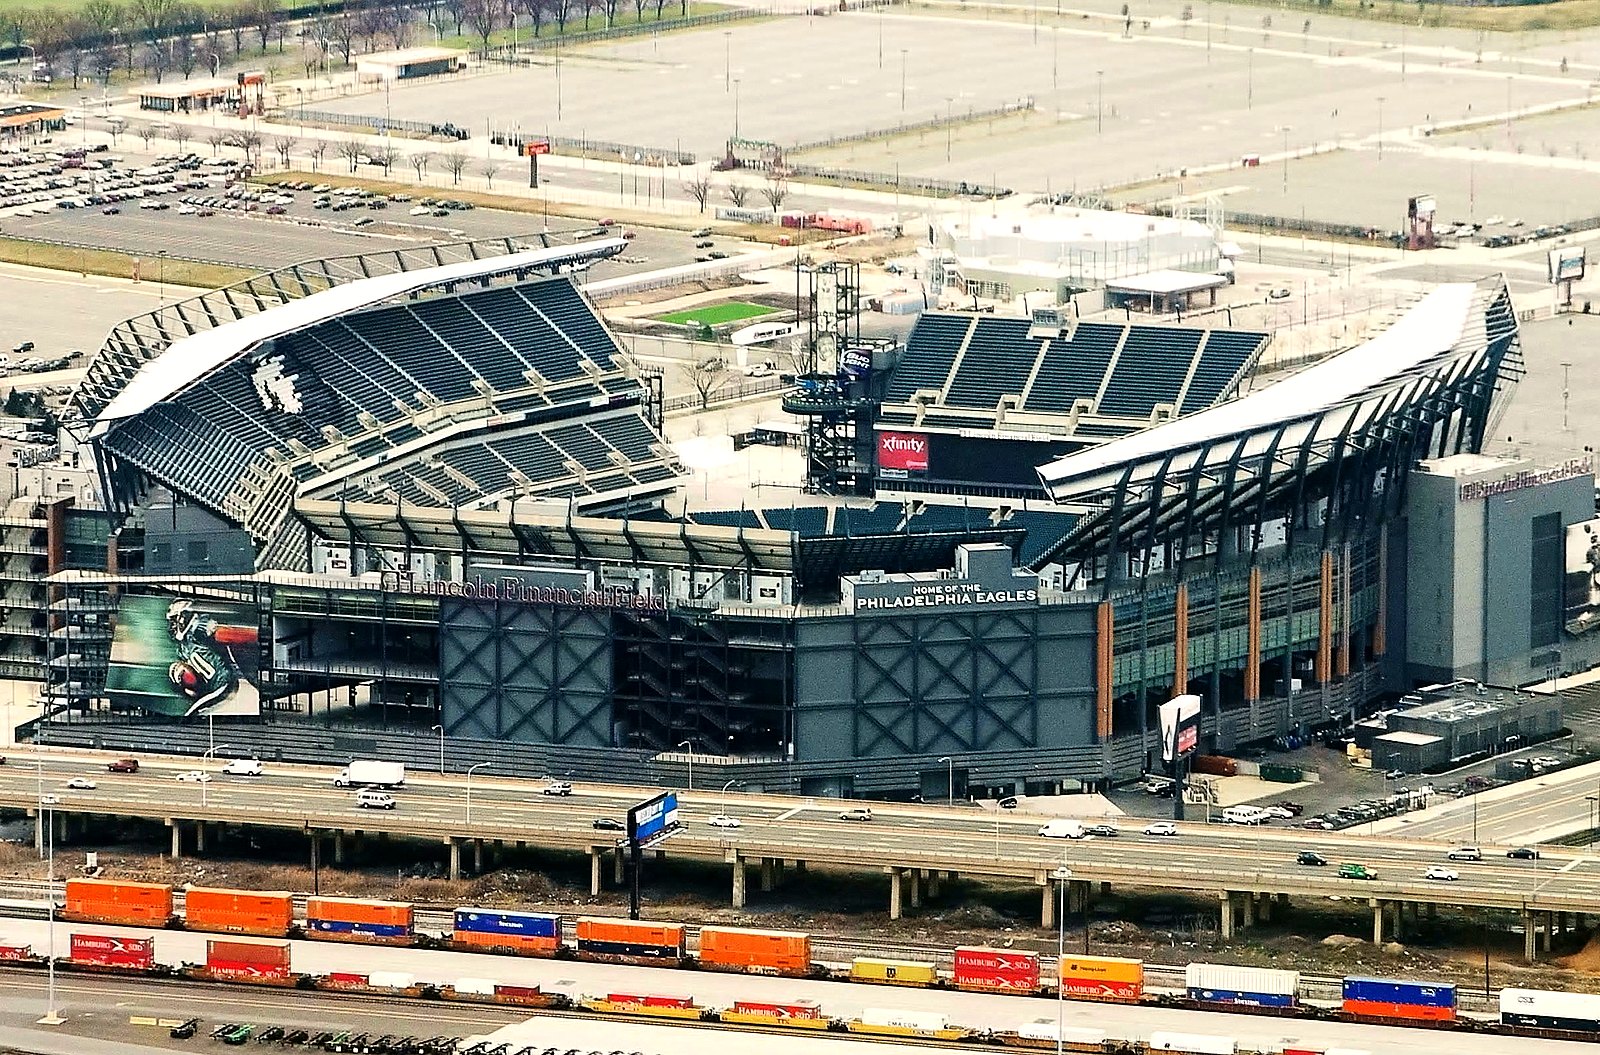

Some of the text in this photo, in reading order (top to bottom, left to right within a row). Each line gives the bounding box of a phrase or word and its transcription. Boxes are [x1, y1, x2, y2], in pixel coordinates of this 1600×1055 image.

[846, 352, 870, 363] BUD
[883, 436, 924, 453] xfinity
[408, 571, 668, 611] Lincoln Financial Field
[912, 583, 981, 595] HOME OF THE
[857, 589, 1037, 610] PHILADELPHIA EAGLES
[74, 938, 111, 949] HAMBURG
[958, 957, 1030, 970] HAMBURG SÜD
[958, 976, 1030, 989] HAMBURG SÜD
[1062, 983, 1134, 997] HAMBURG SÜD
[738, 1006, 779, 1017] HAMBURG
